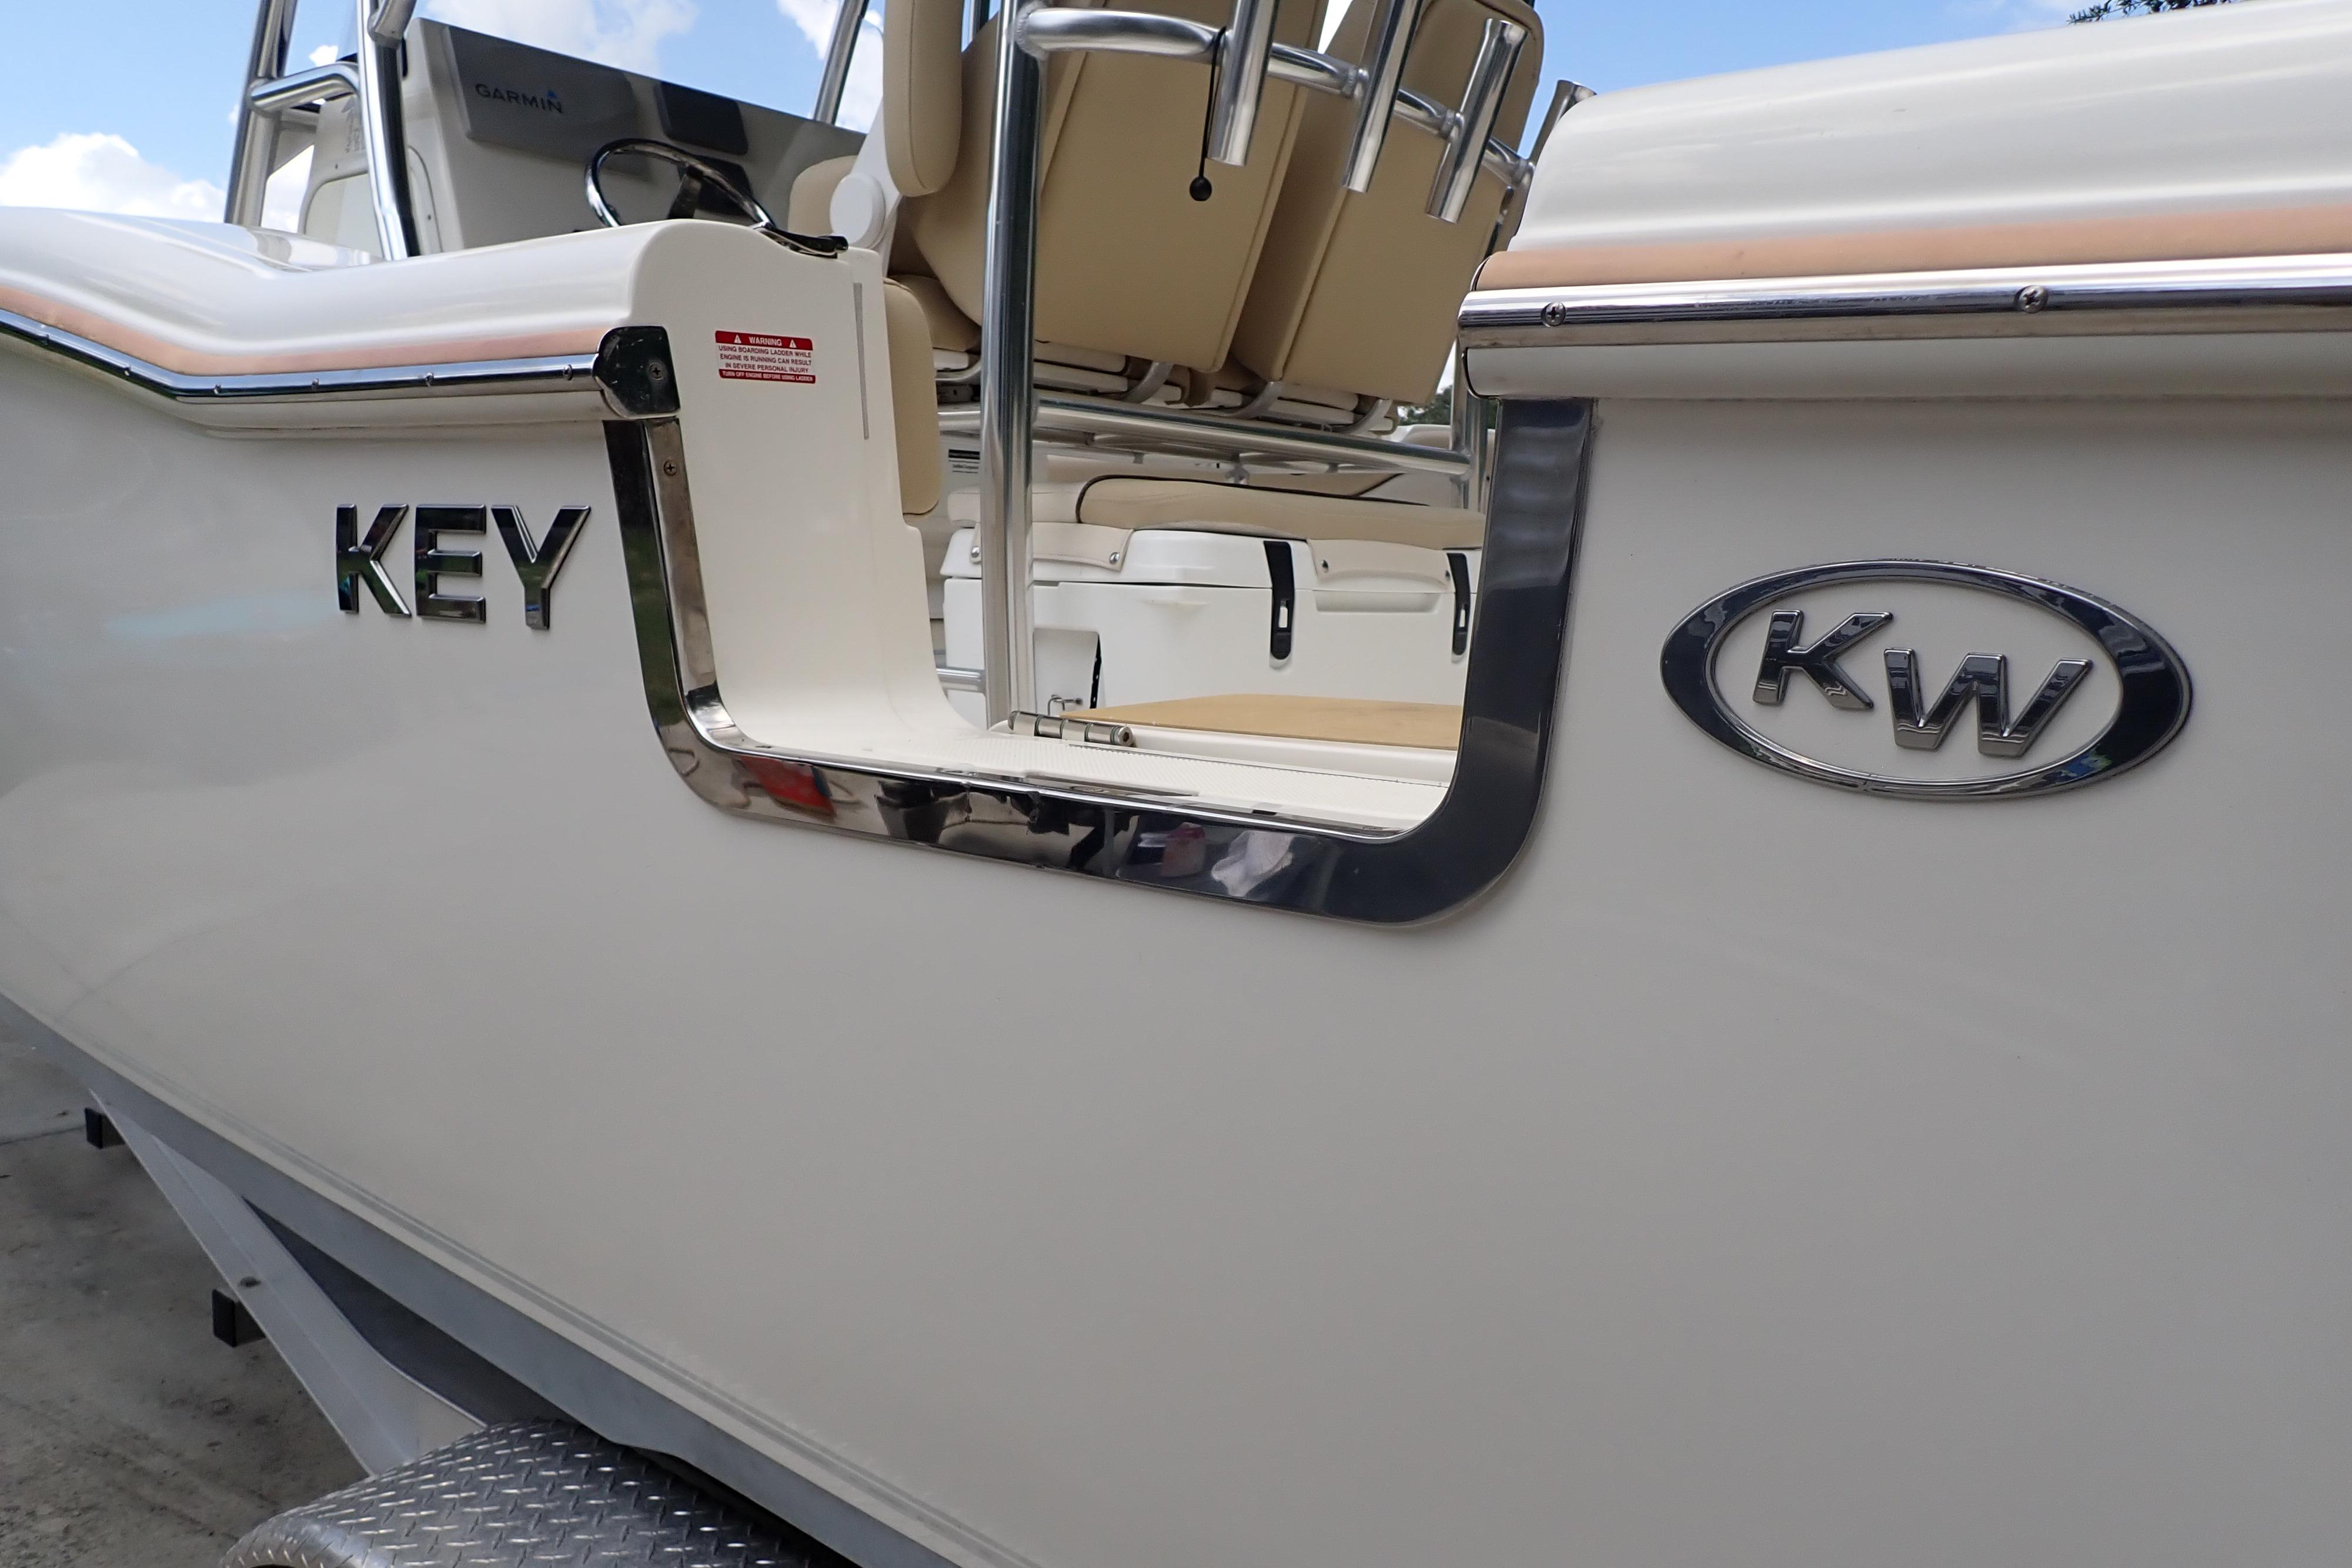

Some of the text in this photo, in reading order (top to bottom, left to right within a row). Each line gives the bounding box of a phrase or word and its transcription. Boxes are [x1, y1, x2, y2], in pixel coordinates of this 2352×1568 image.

[475, 83, 563, 113] GARMIN
[739, 346, 769, 355] BOARDING
[749, 336, 782, 346] WARNING
[757, 364, 788, 372] PERSONAL
[336, 503, 592, 630] KEY
[1753, 609, 2093, 757] KW
